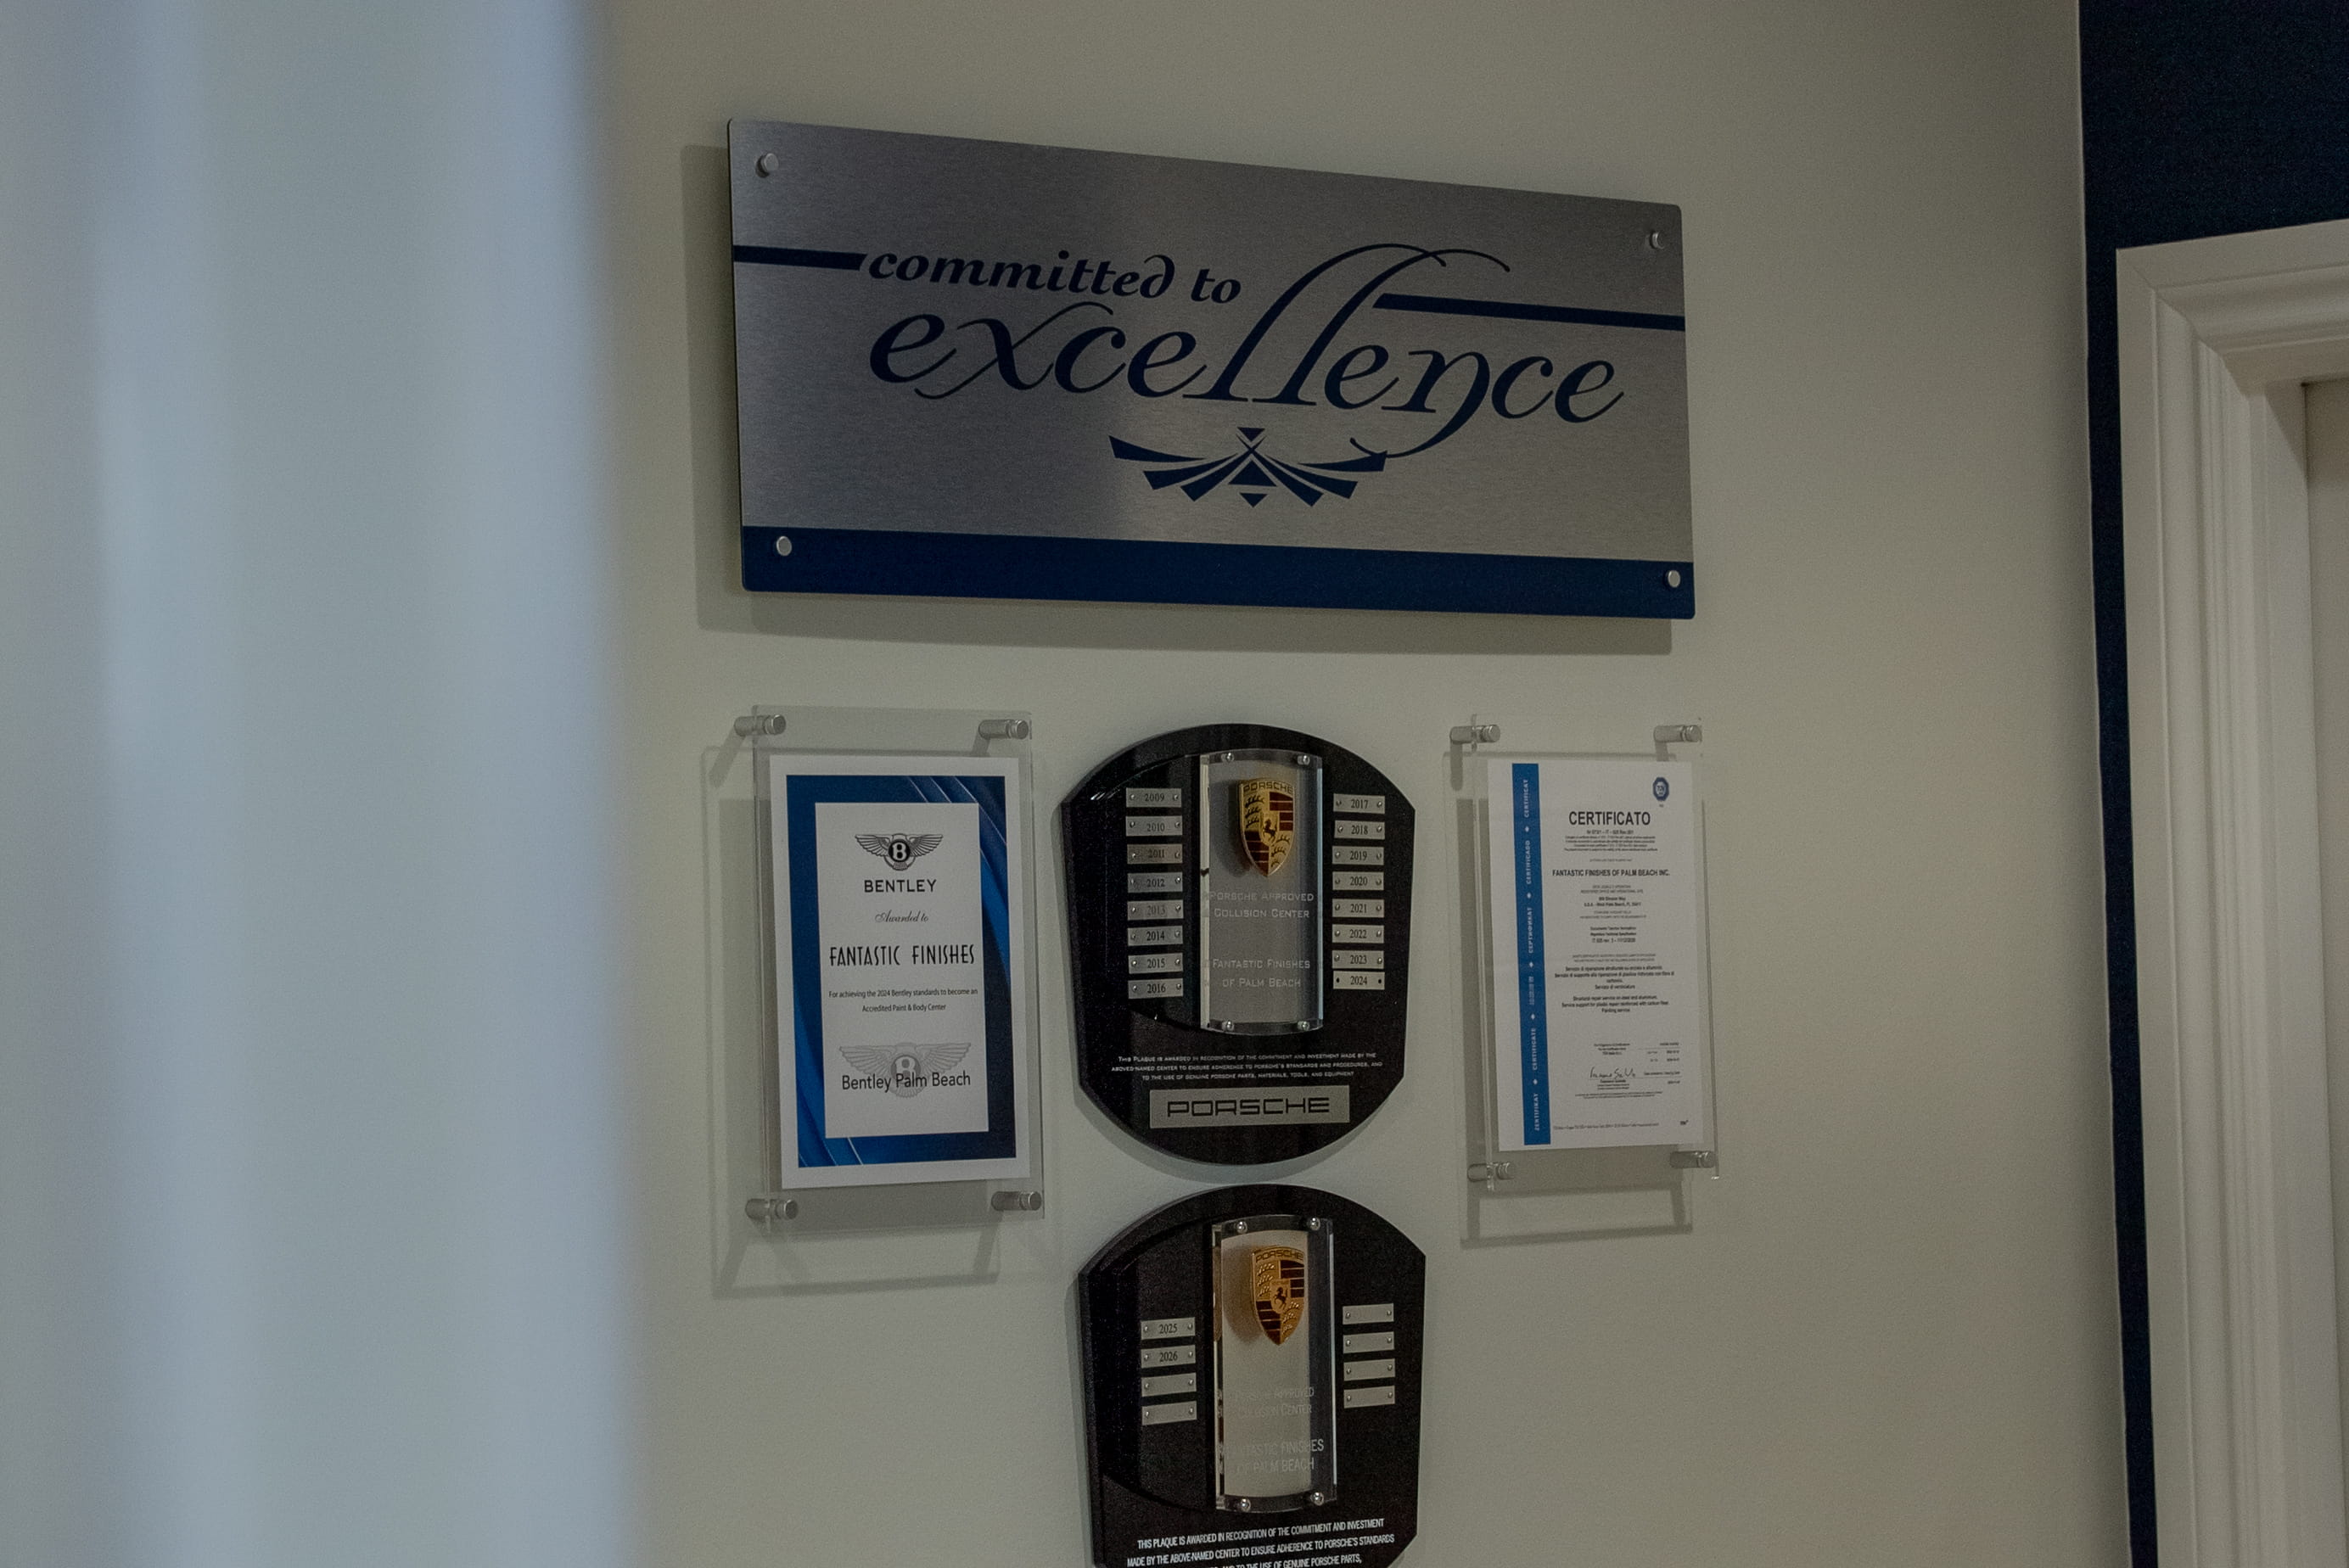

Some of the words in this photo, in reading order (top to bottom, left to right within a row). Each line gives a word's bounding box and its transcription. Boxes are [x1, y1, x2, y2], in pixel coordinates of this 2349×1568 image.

[868, 250, 1175, 299] committed
[1191, 268, 1242, 304] to
[869, 244, 1624, 458] excellence
[1243, 781, 1293, 793] PORSCHE
[1145, 793, 1164, 802] 2009
[1350, 799, 1368, 809] 2017
[1569, 811, 1651, 826] CERTIFICATO
[1146, 822, 1165, 832] 2010
[1351, 825, 1368, 835] 2018
[1148, 849, 1164, 858] 2011
[1349, 851, 1367, 861] 2019
[864, 879, 937, 893] BENTLEY
[1146, 878, 1165, 888] 2012
[1349, 876, 1368, 886] 2020
[1146, 904, 1165, 916] 2013
[1350, 904, 1367, 913] 2021
[875, 910, 919, 923] Awarded
[921, 912, 929, 922] to
[1146, 931, 1164, 941] 2014
[1349, 929, 1367, 938] 2022
[829, 945, 900, 966] FANTASTIC
[911, 944, 975, 965] FINISHES
[1349, 955, 1367, 964] 2023
[1146, 958, 1165, 968] 2015
[1350, 976, 1367, 985] 2024
[1146, 983, 1166, 994] 2016
[839, 990, 866, 1000] achieving
[891, 989, 911, 999] Bentley
[842, 1073, 891, 1093] Bentley
[895, 1072, 927, 1088] Palm
[932, 1071, 971, 1087] Beach
[1168, 1098, 1329, 1117] PORSCHE
[1256, 1249, 1303, 1263] PORSCHE
[1159, 1324, 1178, 1334] 2025
[1159, 1351, 1178, 1362] 2026
[1137, 1539, 1152, 1549] THIS
[1153, 1537, 1178, 1548] PLAQUE
[1179, 1536, 1186, 1545] IS
[1186, 1533, 1217, 1545] AWARDED
[1218, 1532, 1225, 1542] IN
[1225, 1529, 1267, 1541] RECOGNITION
[1268, 1528, 1277, 1537] OF
[1278, 1526, 1290, 1537] THE
[1291, 1523, 1332, 1535] COMMITMENT
[1332, 1521, 1347, 1532] AND
[1347, 1518, 1385, 1530] INVESTMENT
[1127, 1556, 1146, 1567] MADE
[1146, 1555, 1155, 1565] BY
[1157, 1554, 1169, 1565] THE
[1170, 1550, 1214, 1564] ABOVE-NAMED
[1215, 1548, 1240, 1559] CENTER
[1241, 1547, 1250, 1557] TO
[1251, 1544, 1276, 1555] ENSURE
[1276, 1541, 1314, 1554] ADHERENCE
[1315, 1540, 1323, 1549] TO
[1324, 1537, 1359, 1549] PORSCHE'S
[1360, 1534, 1395, 1546] STANDARDS
[1283, 1558, 1310, 1568] GENUINE
[1310, 1554, 1340, 1567] PORSCHE
[1341, 1554, 1362, 1564] PARTS,
